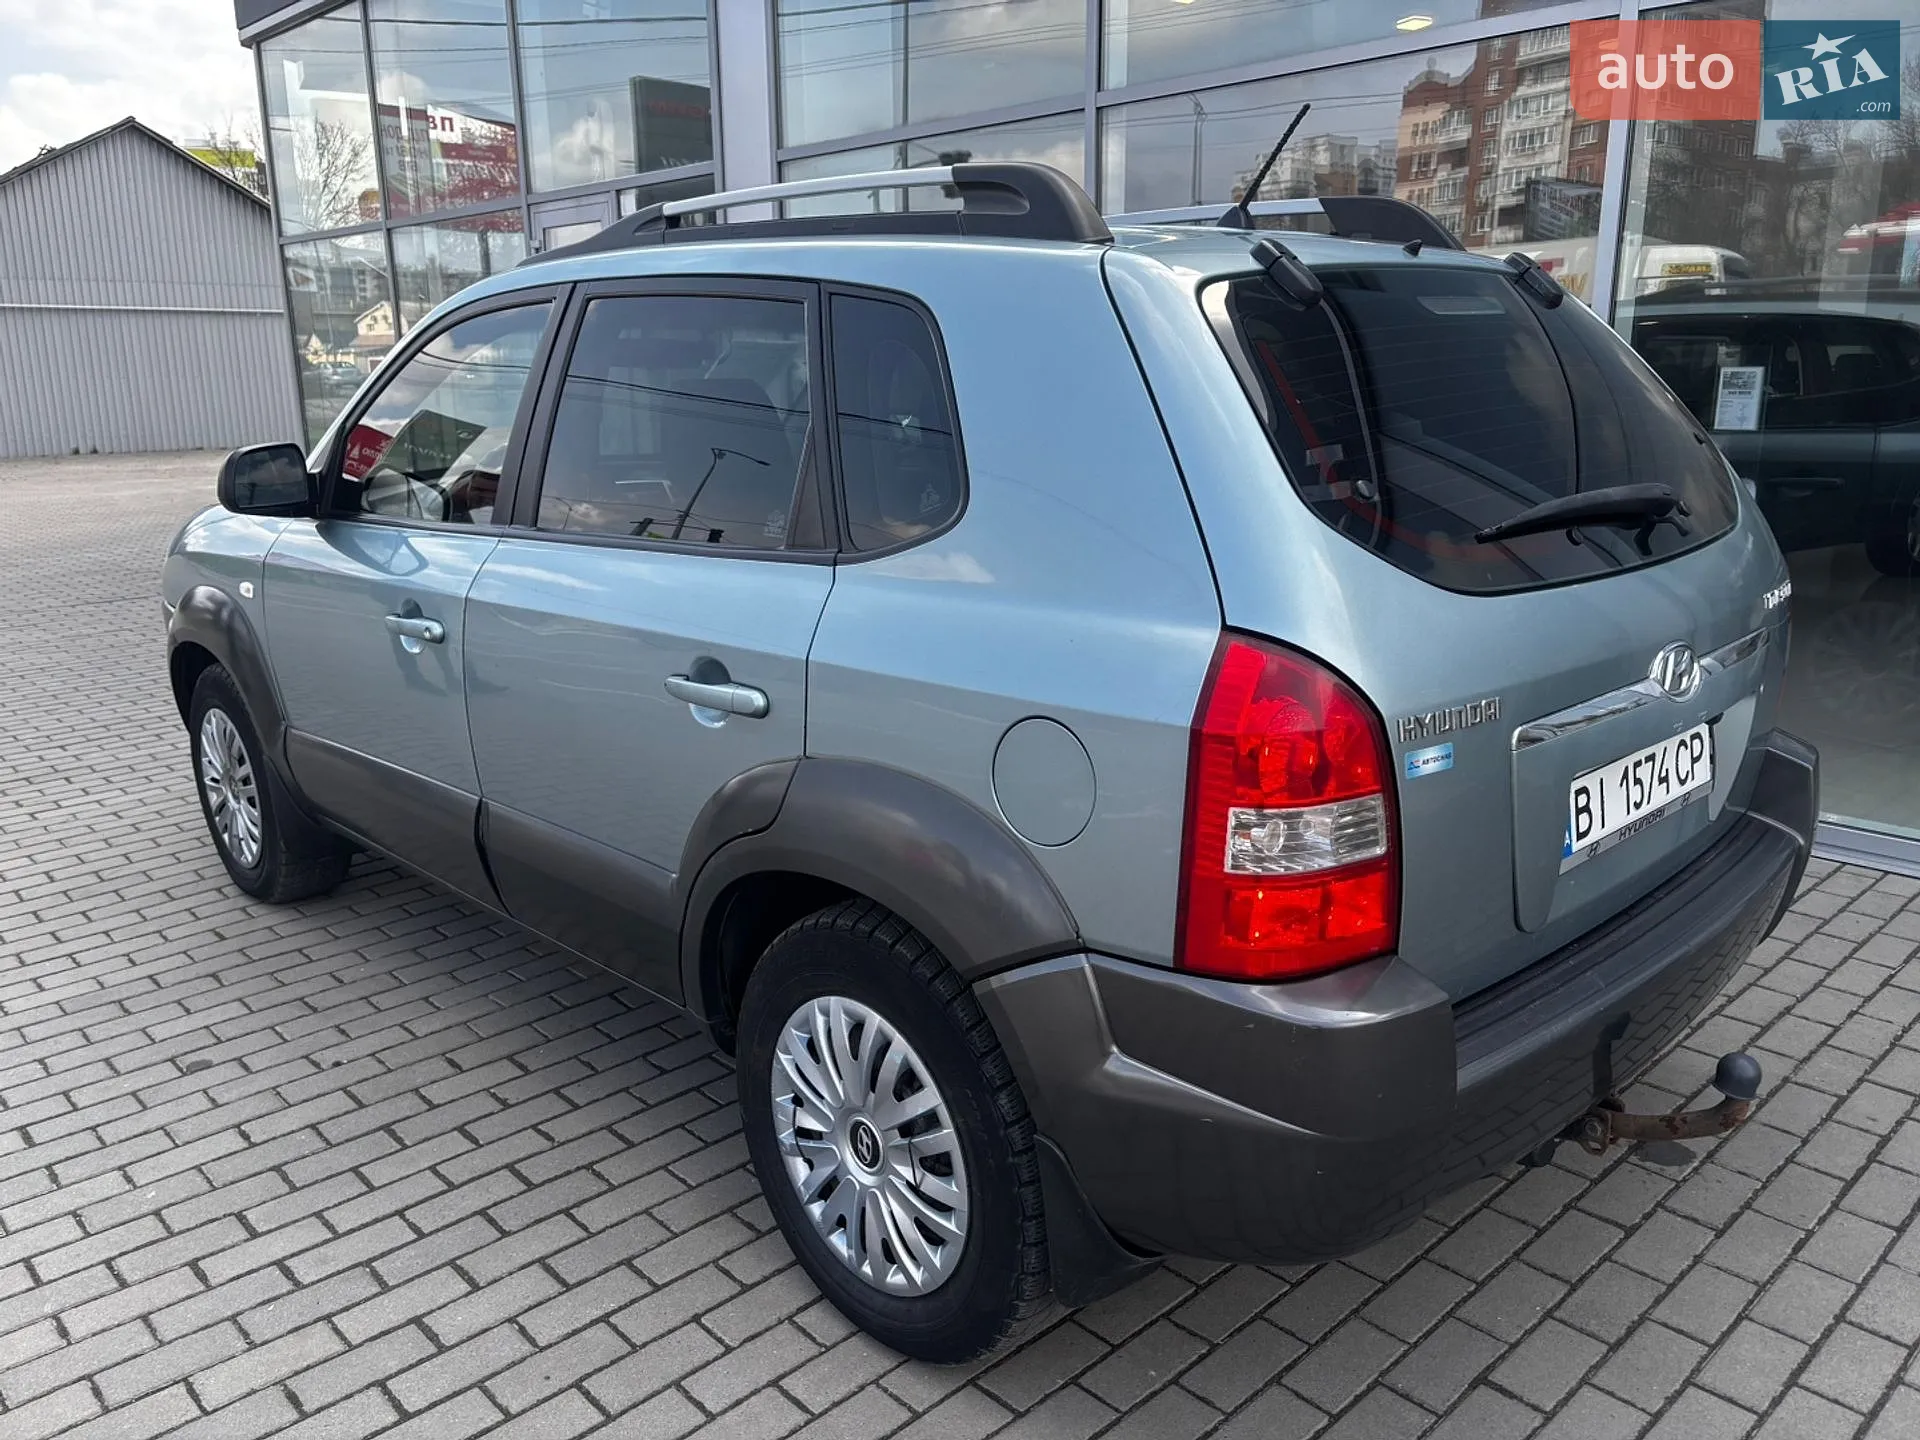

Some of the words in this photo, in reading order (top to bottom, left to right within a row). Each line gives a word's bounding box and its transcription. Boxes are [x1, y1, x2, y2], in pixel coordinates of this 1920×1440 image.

[1397, 697, 1500, 743] HYUNDAI
[1574, 776, 1605, 842] BI
[1619, 746, 1670, 816] 1574
[1675, 731, 1704, 787] CP
[1618, 808, 1667, 841] HYUNDAI
